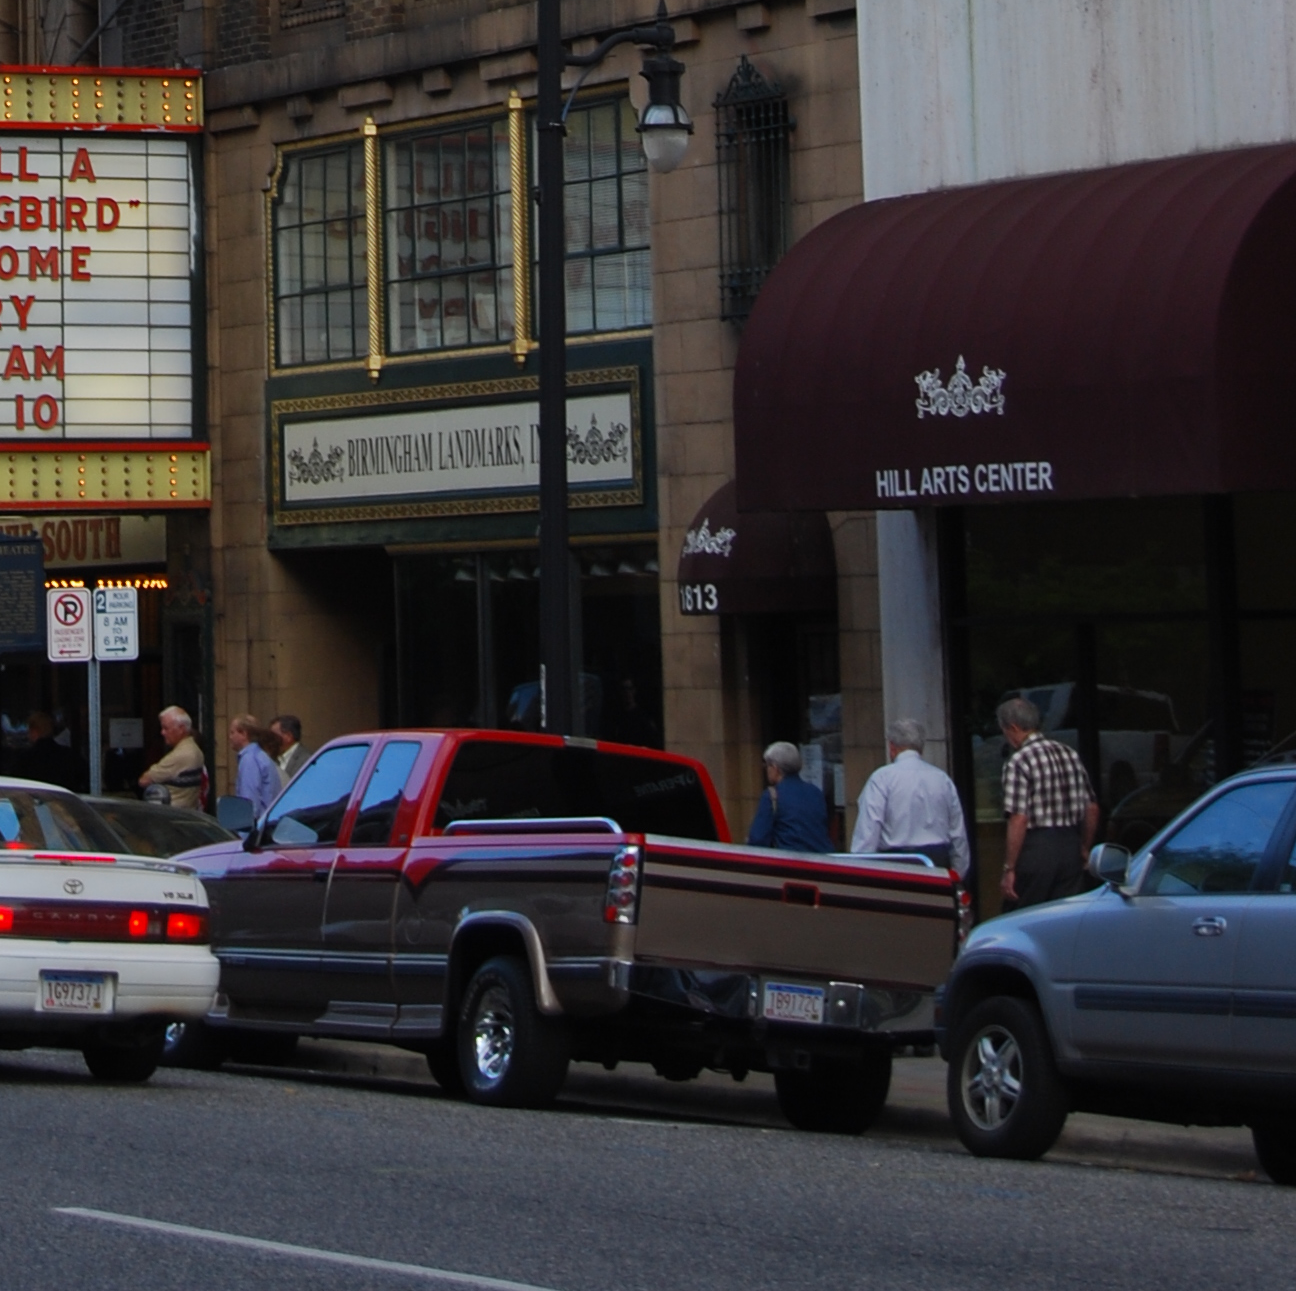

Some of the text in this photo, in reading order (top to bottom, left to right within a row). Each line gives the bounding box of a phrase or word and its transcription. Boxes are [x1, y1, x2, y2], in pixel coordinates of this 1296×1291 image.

[68, 147, 96, 183] A
[15, 394, 59, 431] 10
[347, 431, 434, 477] BIRMINGHAM
[437, 425, 525, 472] LANDMARKS,
[876, 461, 1053, 498] HILL ARTS CENTER
[42, 517, 122, 563] SOUTH
[96, 593, 106, 610] 2
[680, 582, 718, 611] 1813
[114, 617, 128, 626] AM
[114, 636, 129, 645] PM
[31, 912, 116, 921] CAMRY
